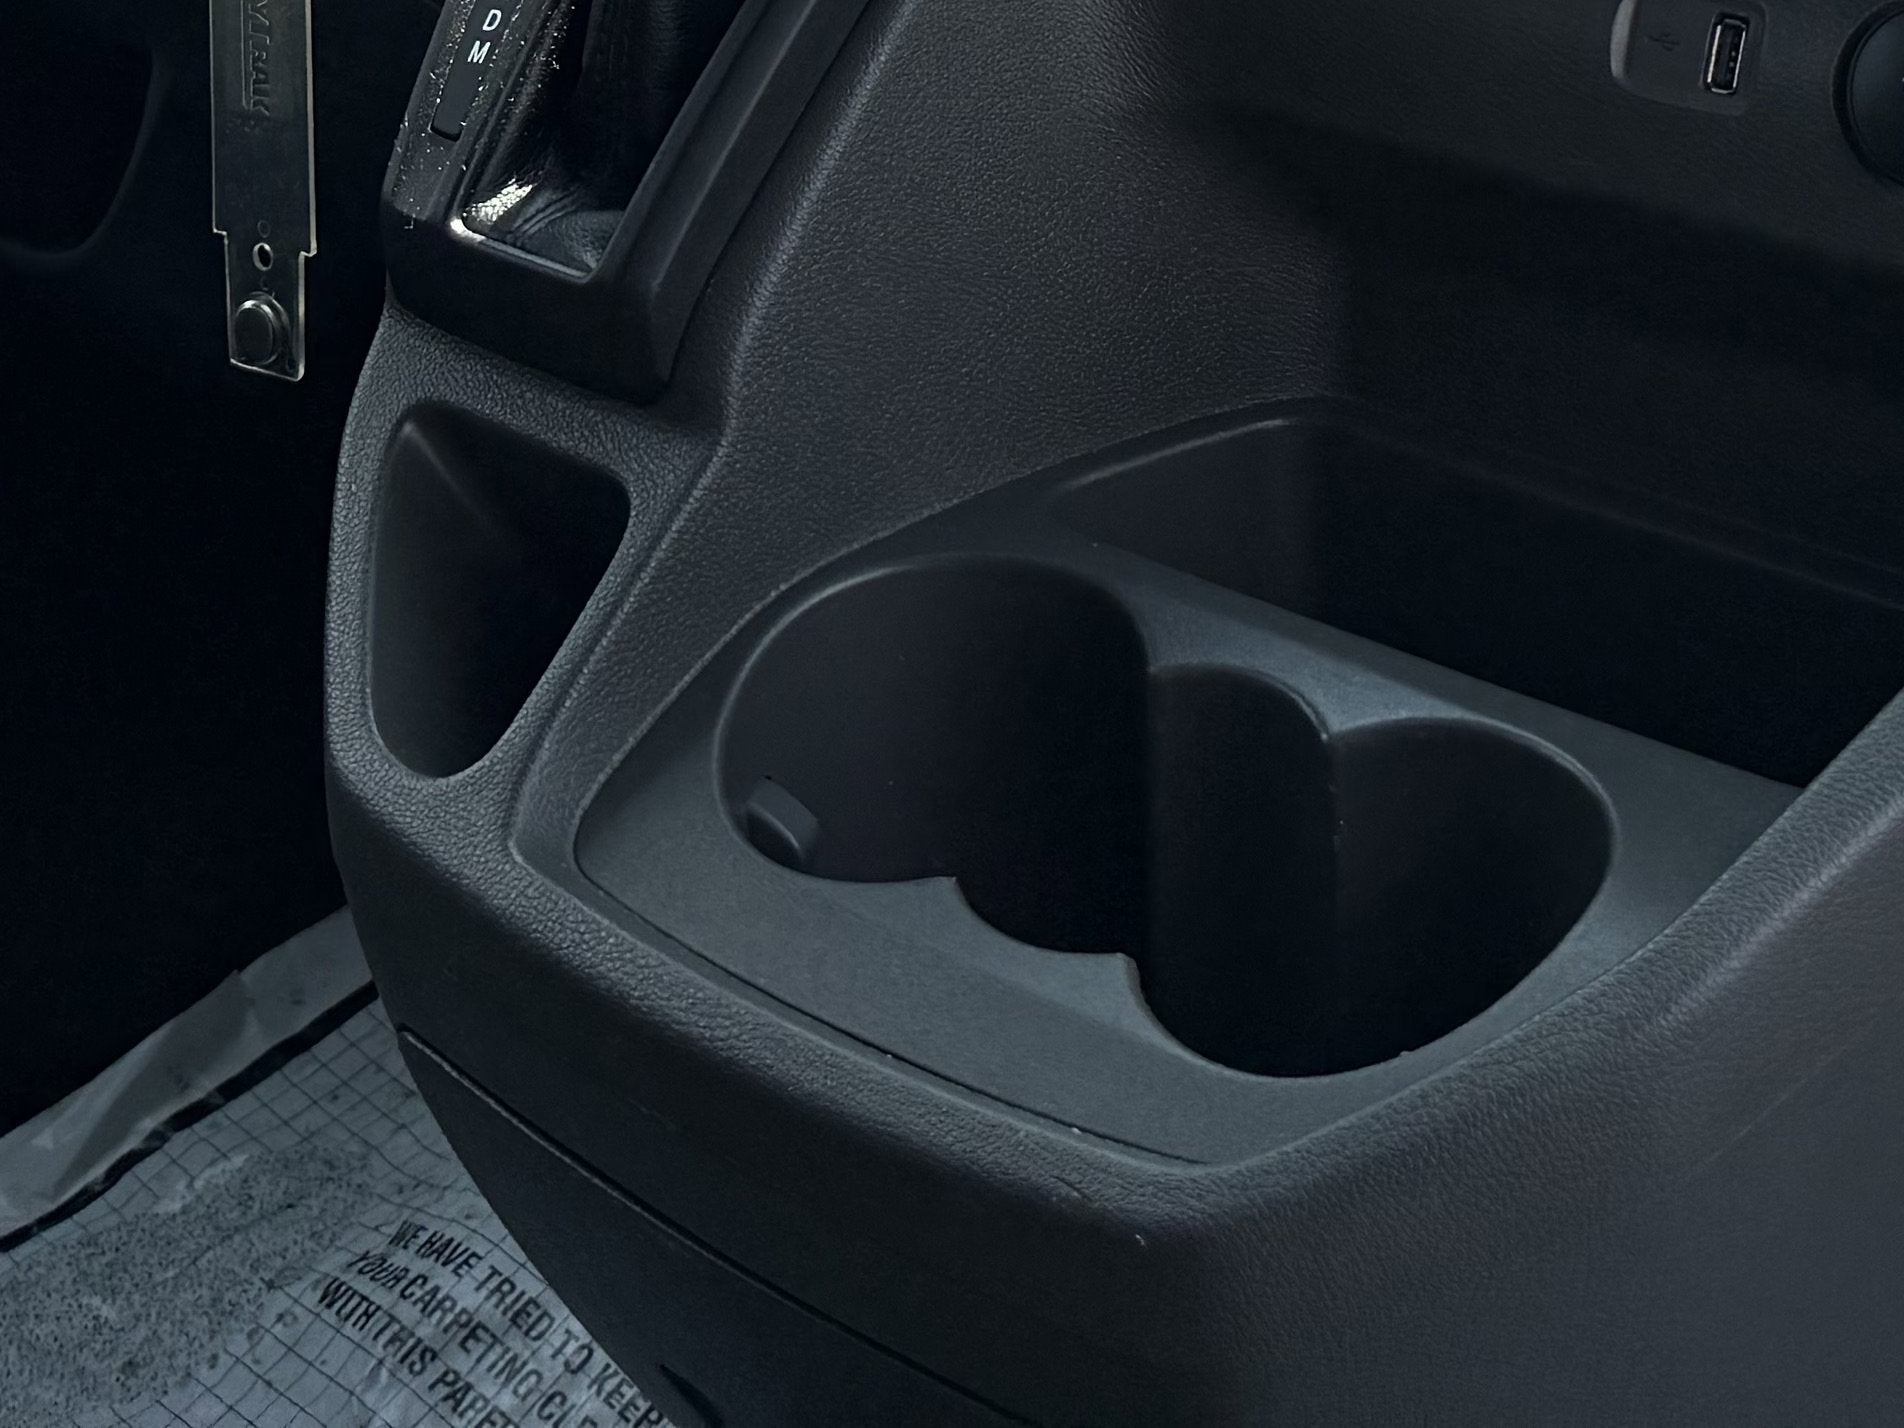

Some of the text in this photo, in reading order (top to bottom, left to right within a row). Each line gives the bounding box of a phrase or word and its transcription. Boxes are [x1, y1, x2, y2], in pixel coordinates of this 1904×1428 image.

[466, 39, 492, 65] M
[481, 8, 502, 32] D
[317, 1277, 382, 1332] WITH
[372, 1314, 438, 1377] THIS
[346, 1250, 410, 1290] YOUR
[399, 1274, 543, 1403] CARPETING
[387, 1219, 428, 1250] WE
[416, 1230, 483, 1279] HAVE
[475, 1265, 556, 1341] TRIED
[550, 1328, 594, 1375] TO
